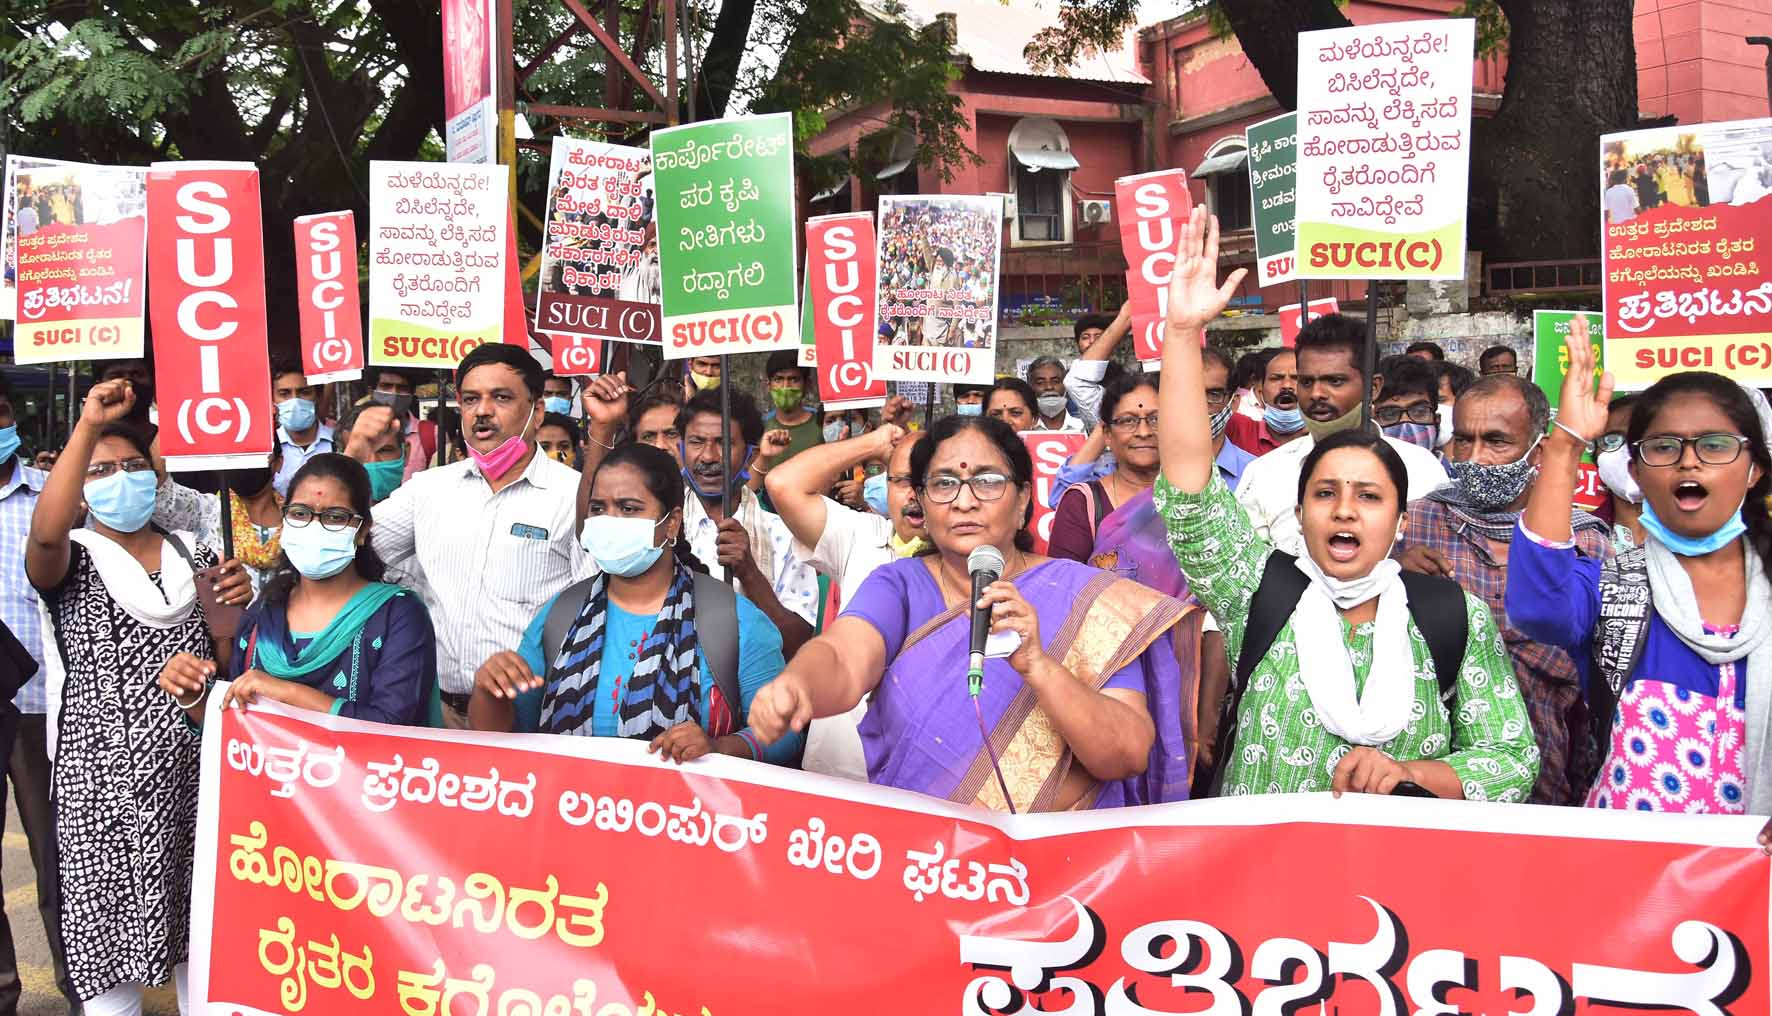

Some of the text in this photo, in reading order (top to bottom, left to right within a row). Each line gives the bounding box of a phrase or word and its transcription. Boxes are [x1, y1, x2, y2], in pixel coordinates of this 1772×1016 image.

[1319, 32, 1449, 64] ಮಳೆಯೆನ್ನದೇ!
[1328, 66, 1435, 97] ಬಿಸಿಲೆನ್ನದೇ,
[1307, 97, 1458, 130] ಸಾವನ್ನು ಲೆಕ್ಕಿಸದೆ
[1303, 130, 1462, 160] ಹೋರಾಡುತ್ತಿರುವ
[568, 148, 641, 174] ಹೋರಾಟ
[387, 171, 490, 197] ಮಳೆಯೆನ್ನದೇ!
[561, 172, 643, 201] ನಿರತ ರೈತರ
[1323, 163, 1436, 195] ರೈತರೊಂದಿಗೆ
[557, 196, 643, 222] ಮೇಲೆ ದಾಳಿ
[680, 177, 760, 212] ಪರ ಕೃಷಿ
[395, 197, 480, 222] ಬಿಸಿಲೆನ್ನದೇ,
[1331, 195, 1424, 225] ನಾವಿದ್ದೇವೆ
[379, 223, 497, 249] ಸಾವನ್ನು ಲೆಕ್ಕಿಸದೆ
[550, 222, 645, 248] ಮಾಡುತ್ತಿರುವ
[679, 218, 765, 251] ನೀತಿಗಳು
[1608, 216, 1717, 240] ಉತ್ತರ ಪ್ರದೇಶದ
[375, 248, 500, 273] ಹೋರಾಡುತ್ತಿರುವ
[1310, 239, 1443, 271] SUCI(C)
[1609, 236, 1755, 260] ಹೋರಾಟನಿರತ ರೈತರ
[683, 261, 765, 299] ರದ್ದಾಗಲಿ
[1266, 257, 1294, 279] SU
[1609, 261, 1760, 286] ಕಗ್ಗೊಲೆಯನ್ನು ಖಂಡಿಸಿ
[23, 277, 132, 319] ಪ್ರತಿಭಟನೆ!
[392, 273, 480, 298] ರೈತರೊಂದಿಗೆ
[400, 300, 472, 325] ನಾವಿದ್ದೇವೆ
[549, 302, 656, 341] SUCI (C)
[33, 325, 121, 346] SUCI (C)
[672, 311, 784, 348] SUCI(C)
[892, 351, 972, 376] SUCI (C)
[1635, 346, 1713, 369] SUCI
[1725, 342, 1772, 370] (C)
[226, 737, 1030, 906] ಉತ್ತರ ಪ್ರದೇಶದ ಲಖಿಂಪುರ್ ಖೇರಿ ಘಟನೆ
[229, 820, 609, 948] ಹೋರಾಟನಿರತ
[258, 916, 376, 1012] ರೈತರ
